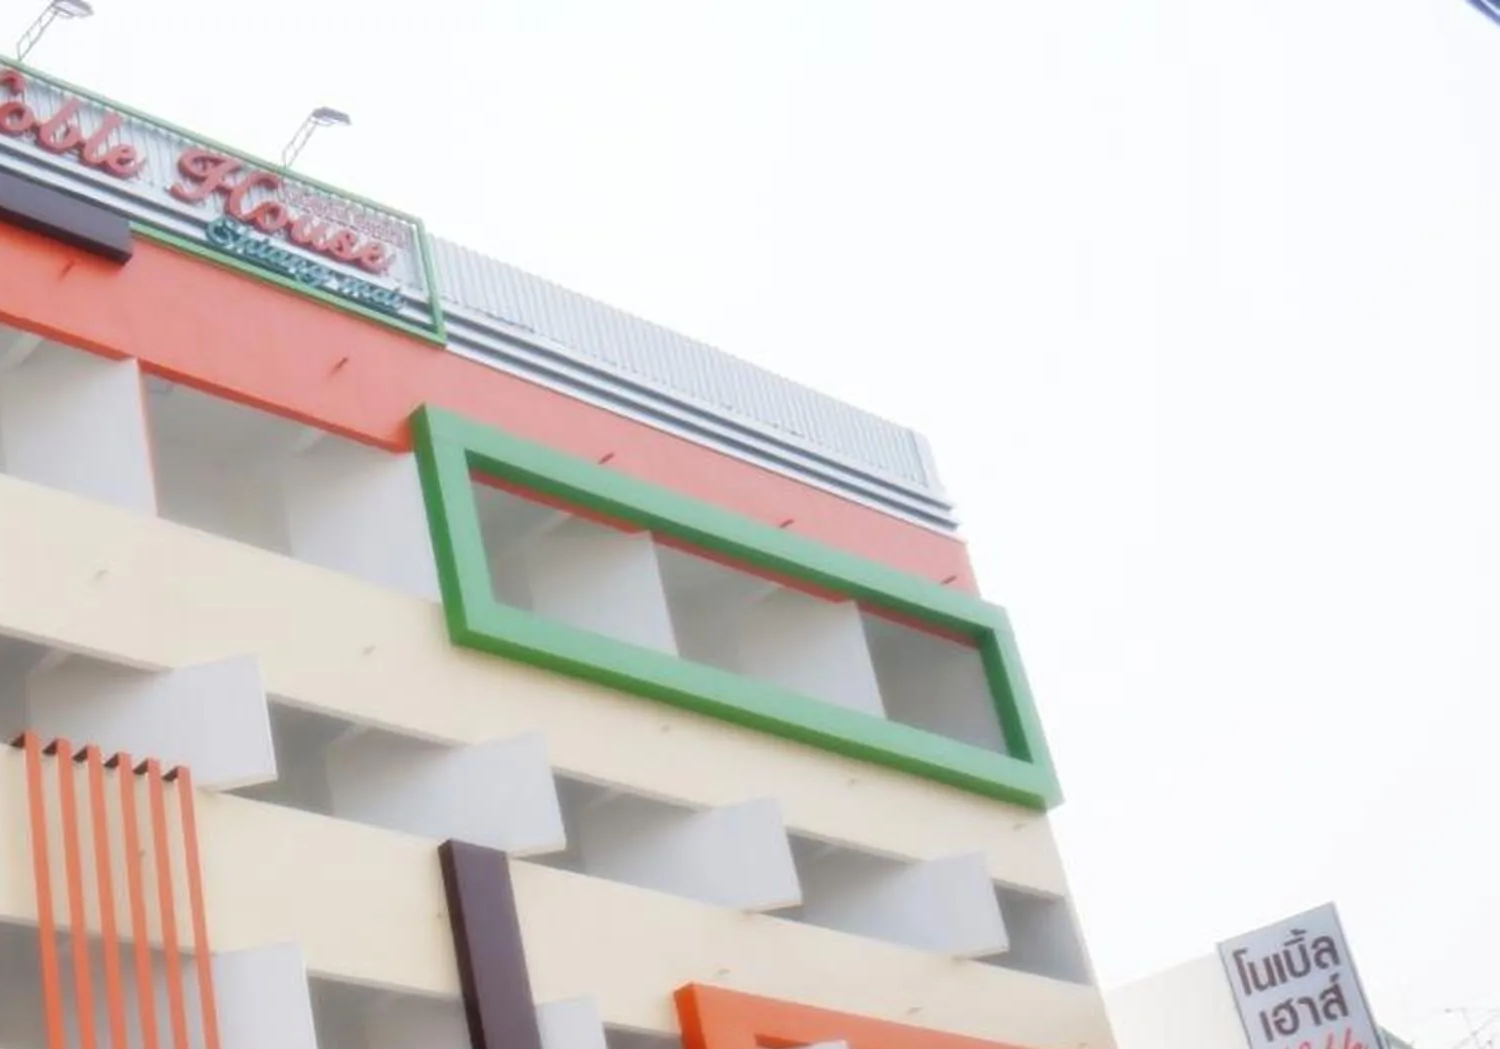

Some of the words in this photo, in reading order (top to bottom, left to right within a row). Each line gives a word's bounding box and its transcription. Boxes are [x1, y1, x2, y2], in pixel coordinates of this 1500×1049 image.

[169, 147, 398, 276] House
[1232, 929, 1341, 996] โนเบิ้ล
[1259, 973, 1350, 1042] เฮาส์
